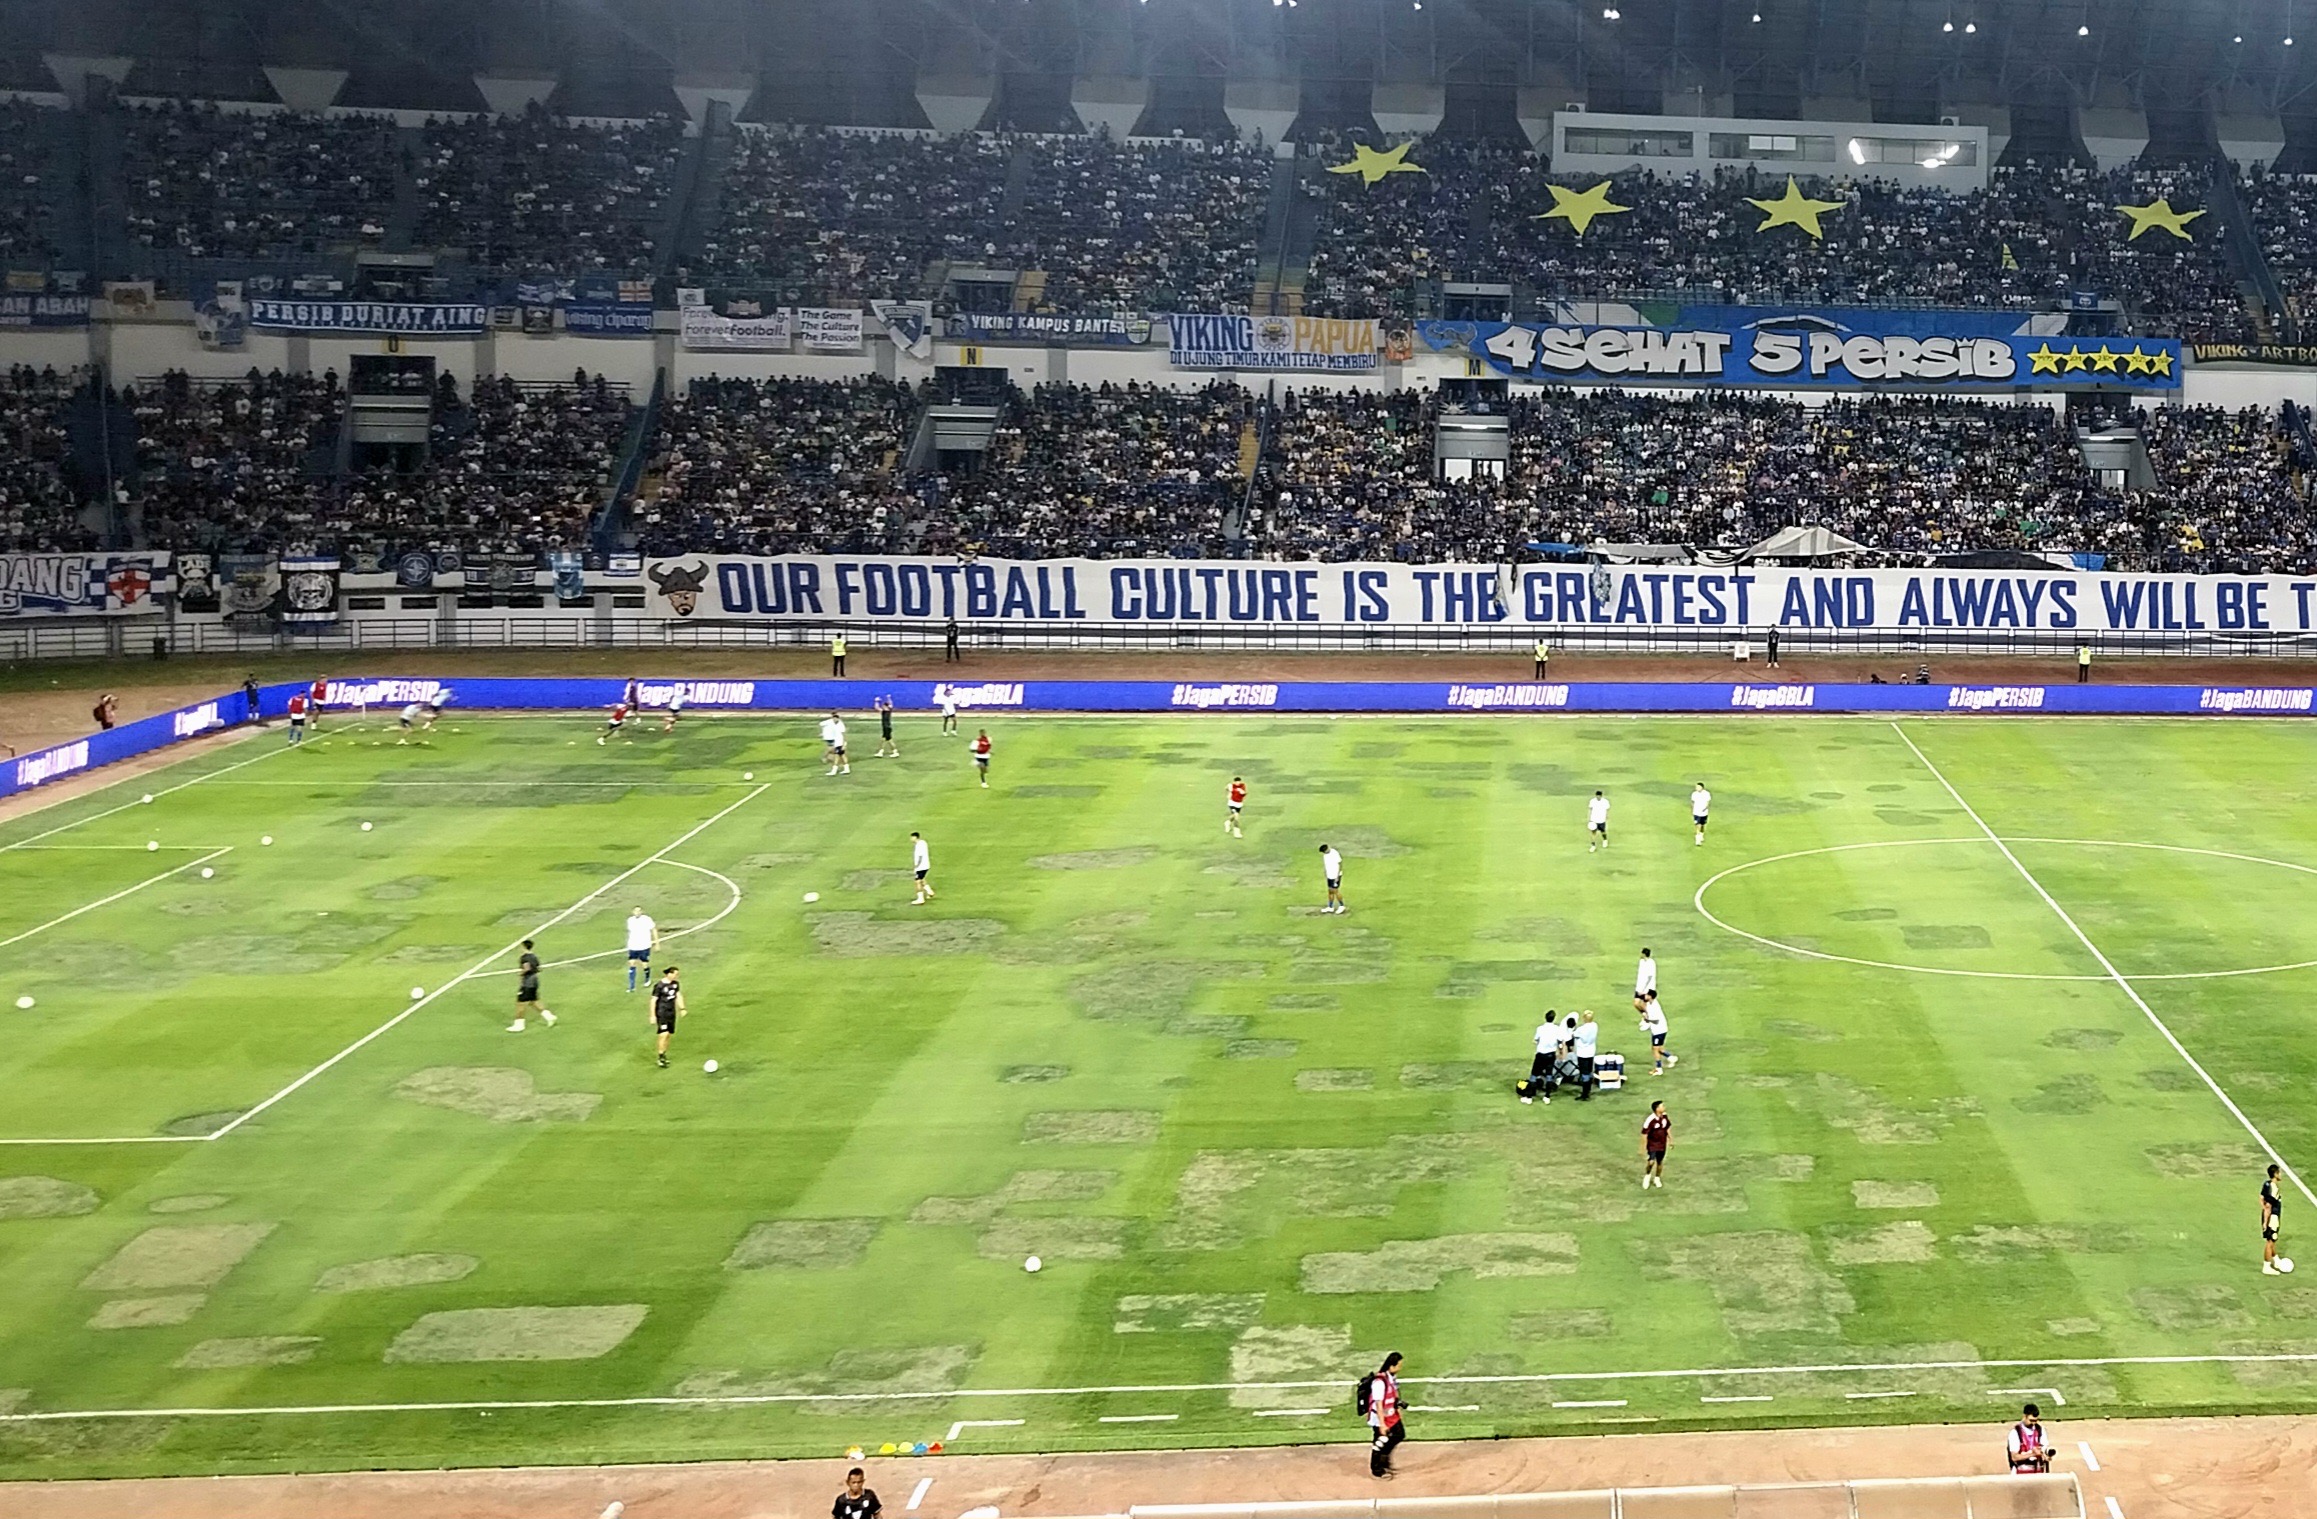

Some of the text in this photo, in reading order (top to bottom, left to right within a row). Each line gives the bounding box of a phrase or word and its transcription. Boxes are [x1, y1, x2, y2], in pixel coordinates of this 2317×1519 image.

[252, 302, 334, 322] PERSIB
[341, 305, 426, 325] DURIAT
[432, 307, 487, 325] AING
[801, 310, 819, 319] The
[822, 311, 853, 321] Game
[971, 314, 1012, 330] VIKING
[1017, 316, 1070, 333] KAMPUS
[801, 321, 860, 332] The Culture
[821, 333, 860, 343] Passion
[1169, 314, 1254, 351] VIKING
[1293, 316, 1376, 354] PAPUA
[966, 347, 977, 366] N
[1184, 351, 1223, 366] UJUNG
[1225, 352, 1260, 367] TIMUR
[1260, 353, 1291, 367] KAMI
[1290, 353, 1326, 368] TETAP
[1327, 354, 1377, 369] MEMBIRU
[1486, 325, 1538, 368] 4
[1748, 330, 1803, 375] 5
[2195, 344, 2249, 359] VIKING
[1469, 359, 1481, 376] M
[716, 562, 824, 614] OUR
[834, 562, 1087, 618] FOOTBALL
[1110, 567, 1320, 622] CULTURE
[1343, 570, 1389, 623] IS
[1412, 571, 1503, 623] THE
[1780, 576, 1875, 628] AND
[1898, 577, 2078, 629] ALWAYS
[2099, 579, 2206, 630] WILL
[2216, 581, 2270, 630] BE
[2290, 583, 2317, 628] T
[1170, 684, 1279, 709] #JagaPERSIB
[1447, 685, 1570, 708] #JagaBANDUNG
[1731, 685, 1815, 709] #JagaGBLA
[1948, 687, 2045, 711] #JagaPERSIB
[2200, 688, 2314, 711] #JagaBANDUNG
